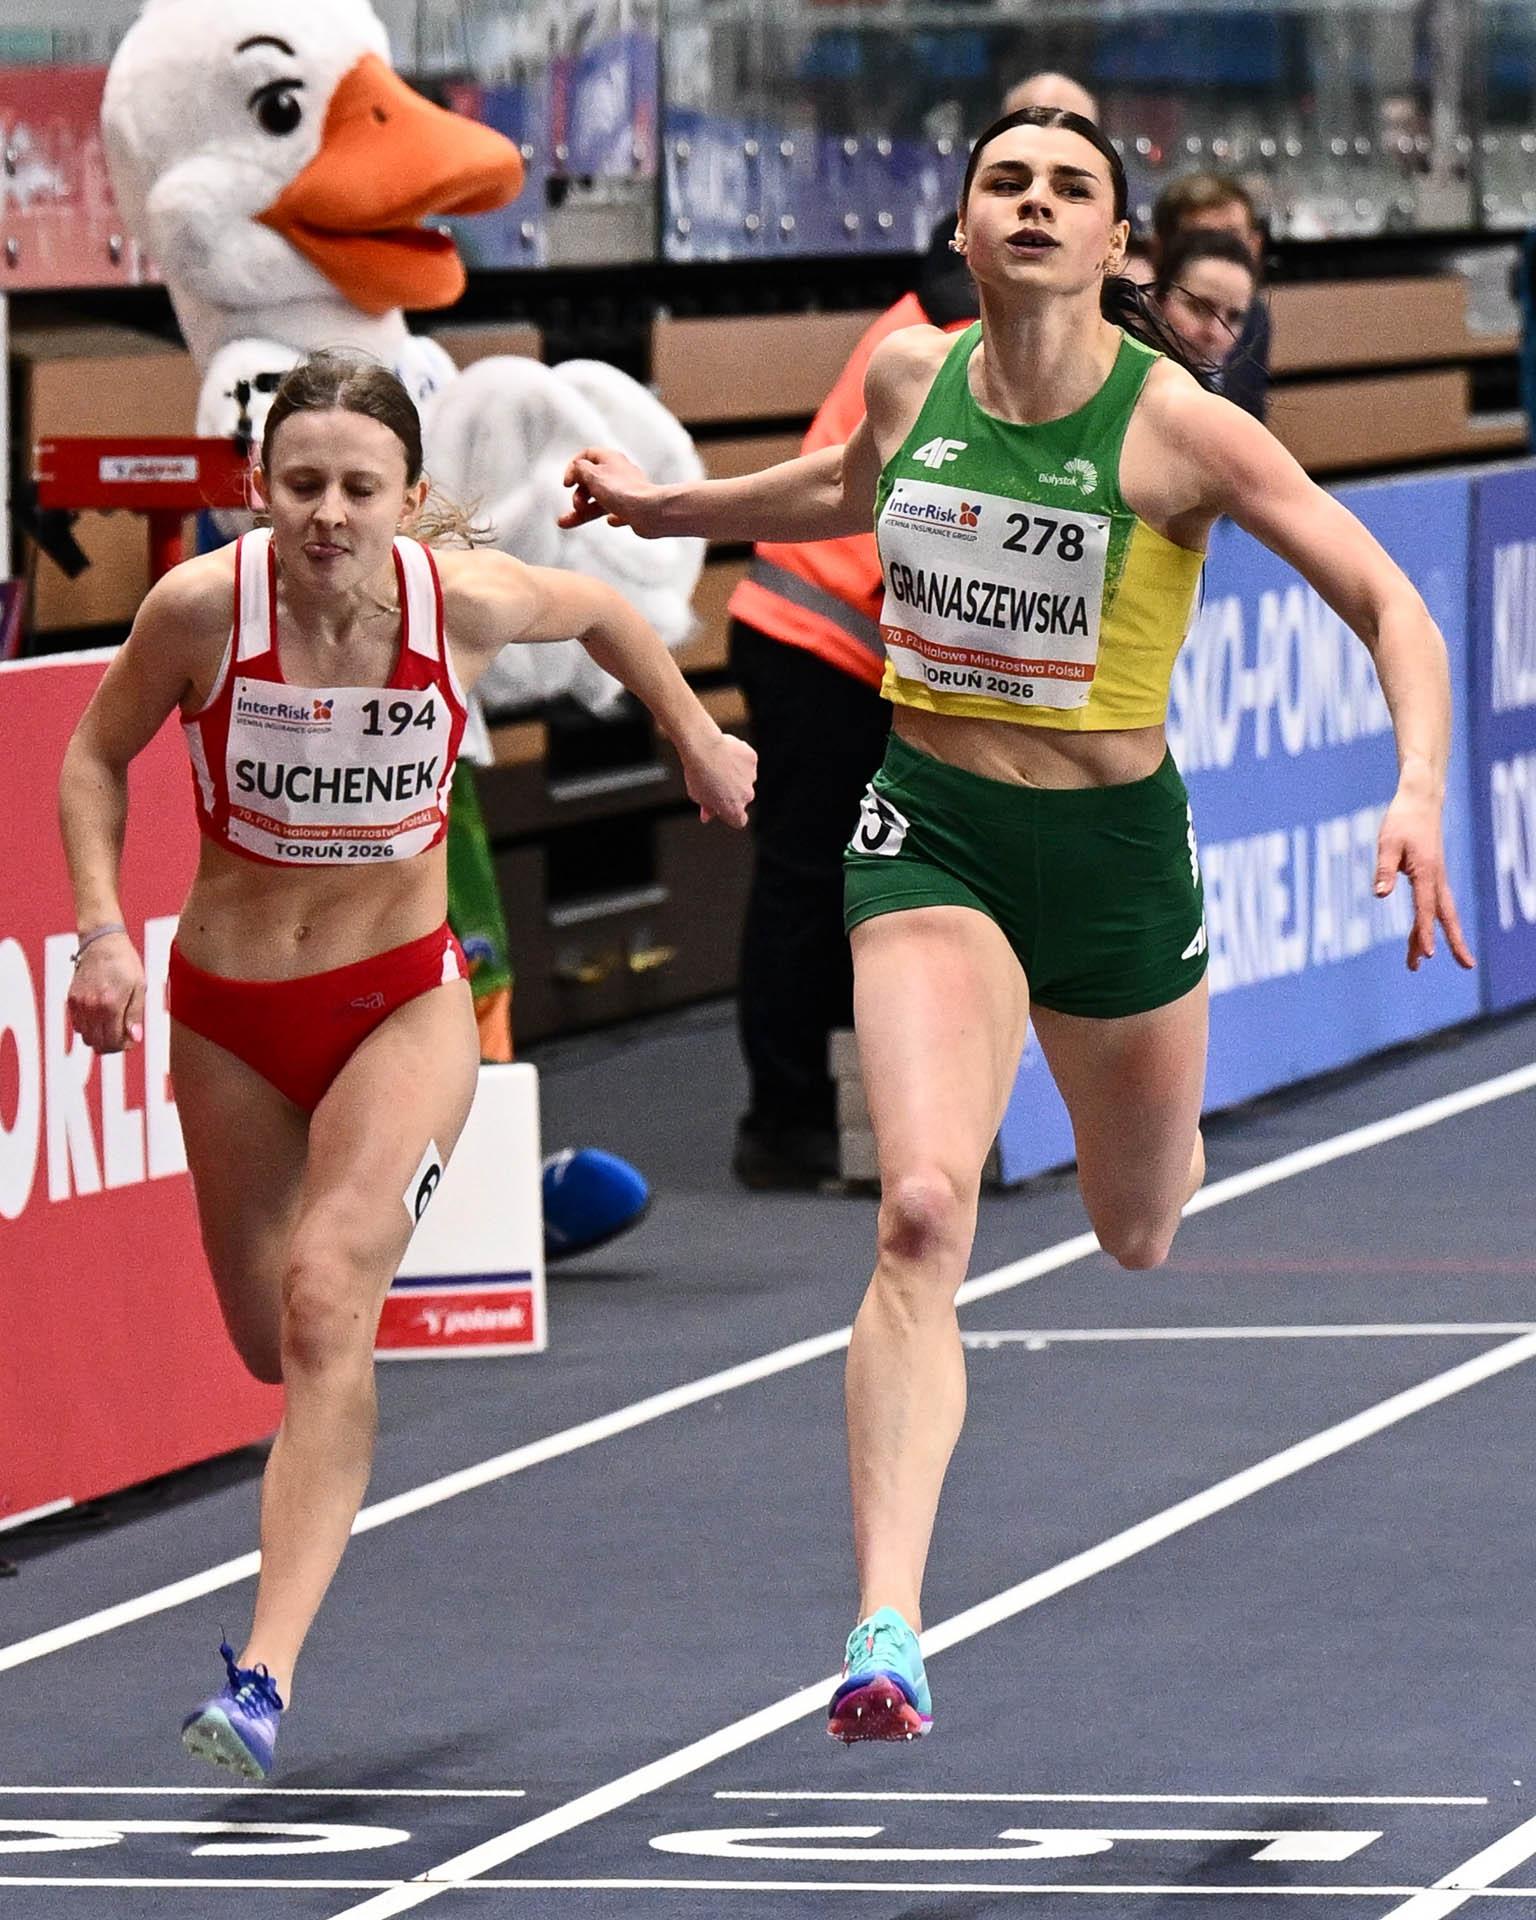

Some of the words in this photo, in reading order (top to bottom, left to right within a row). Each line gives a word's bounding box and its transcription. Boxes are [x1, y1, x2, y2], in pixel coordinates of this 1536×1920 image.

[911, 437, 969, 470] 4F
[888, 498, 957, 525] InterRisk
[1002, 512, 1085, 562] 278
[890, 561, 1089, 637] GRANASZEWSKA
[887, 629, 904, 644] 70.
[923, 643, 968, 663] Halowe
[969, 653, 1045, 675] Mistrzostwa
[1047, 664, 1086, 678] Polski
[986, 677, 1034, 699] 2026
[237, 697, 310, 721] InterRisk
[361, 699, 436, 737] 194
[235, 755, 439, 804] SUCHENEK
[239, 810, 256, 824] 70.
[282, 825, 329, 839] Halowe
[276, 841, 343, 858] TORUŃ
[348, 845, 394, 858] 2026
[415, 1163, 441, 1225] 6
